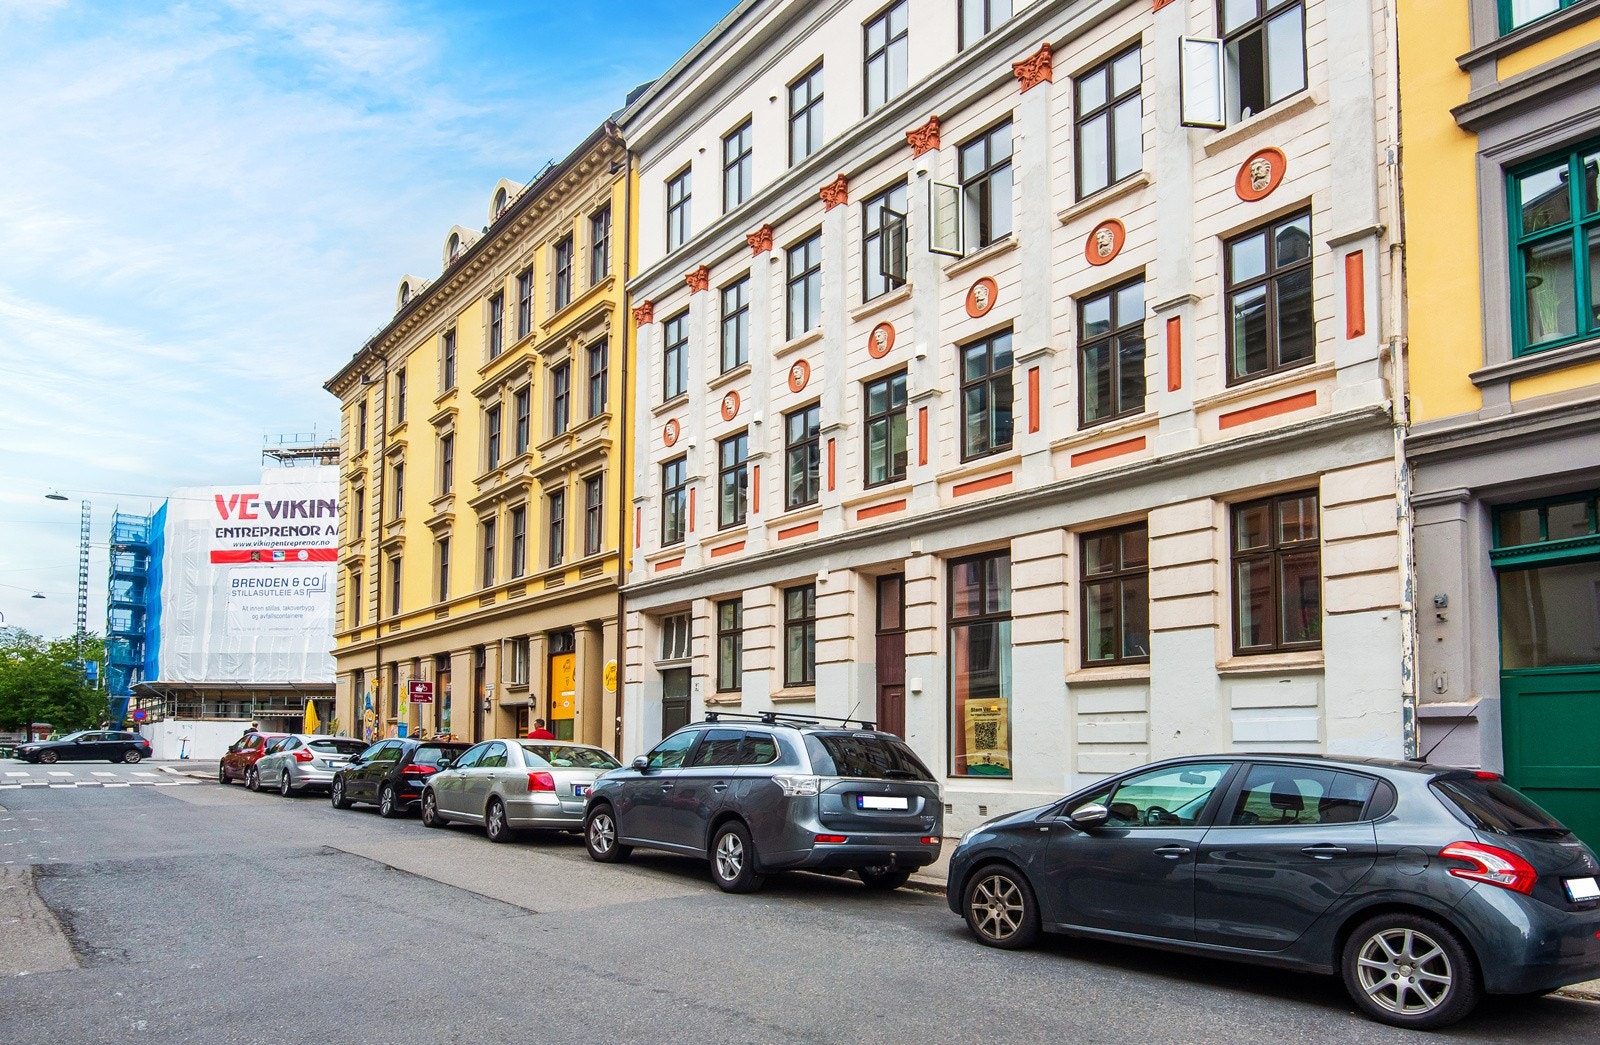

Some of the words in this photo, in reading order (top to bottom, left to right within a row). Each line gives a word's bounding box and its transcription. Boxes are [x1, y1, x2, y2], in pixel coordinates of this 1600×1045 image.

[214, 494, 260, 520] VE
[264, 499, 340, 520] VIKIN
[216, 526, 321, 538] ENTREPRENOR
[324, 525, 340, 536] A
[233, 540, 331, 548] www.vikingentreprenor.no
[232, 578, 288, 588] BRENDEN
[292, 578, 300, 587] &
[304, 577, 320, 586] CO
